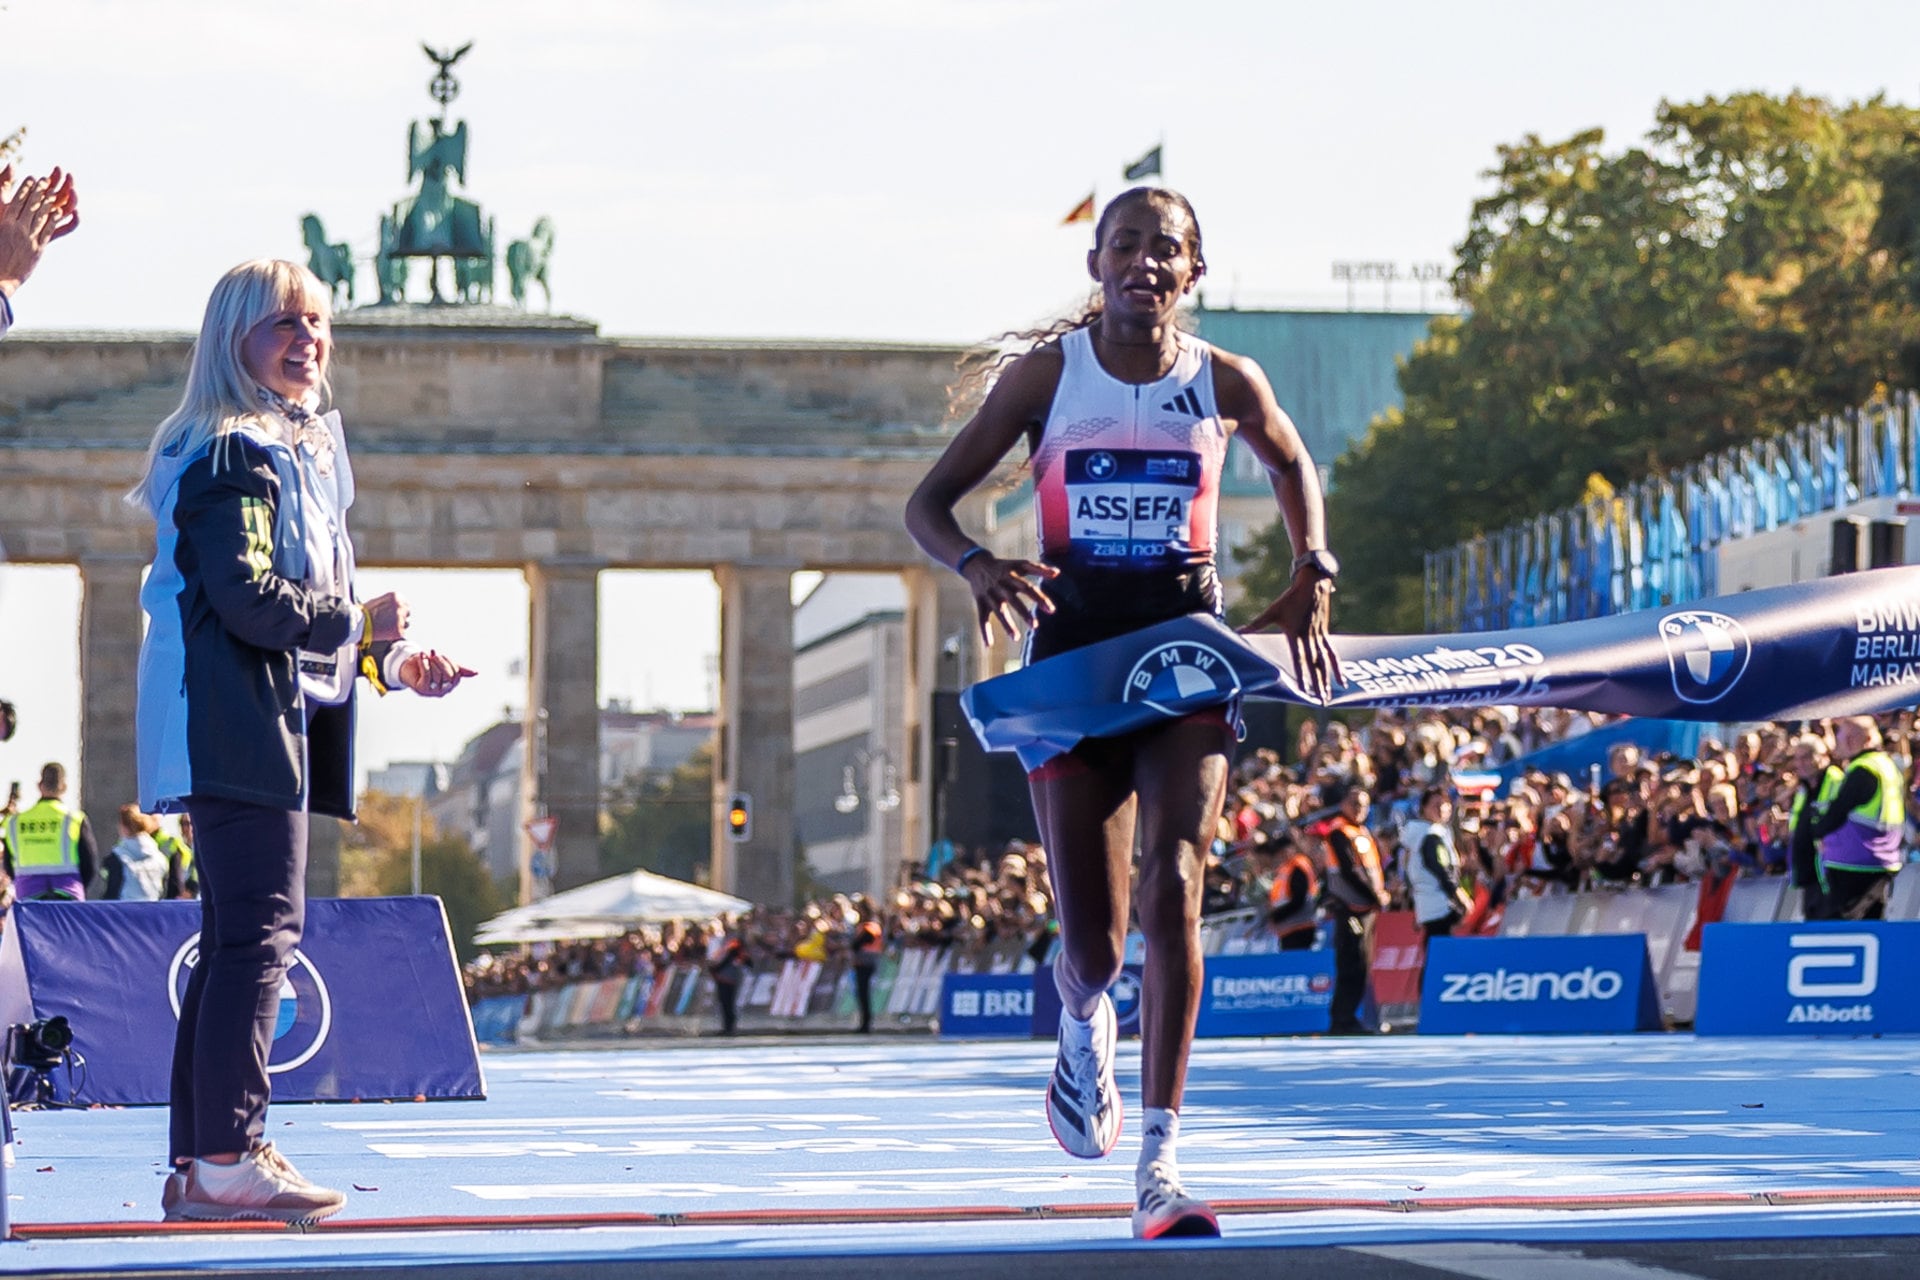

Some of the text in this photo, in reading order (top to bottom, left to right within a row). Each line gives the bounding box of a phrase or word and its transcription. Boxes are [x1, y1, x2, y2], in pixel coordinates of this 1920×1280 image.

[1331, 260, 1398, 281] HOTEL
[1077, 495, 1182, 521] ASSEFA
[1665, 613, 1731, 636] BMW
[1854, 633, 1920, 659] BERLI
[1133, 648, 1216, 691] BMW
[1339, 643, 1545, 681] BMW 20
[1356, 669, 1453, 695] BERLIN
[1212, 975, 1308, 997] ERDINGER
[1439, 966, 1623, 1002] zalando
[1786, 1003, 1874, 1023] Abbott
